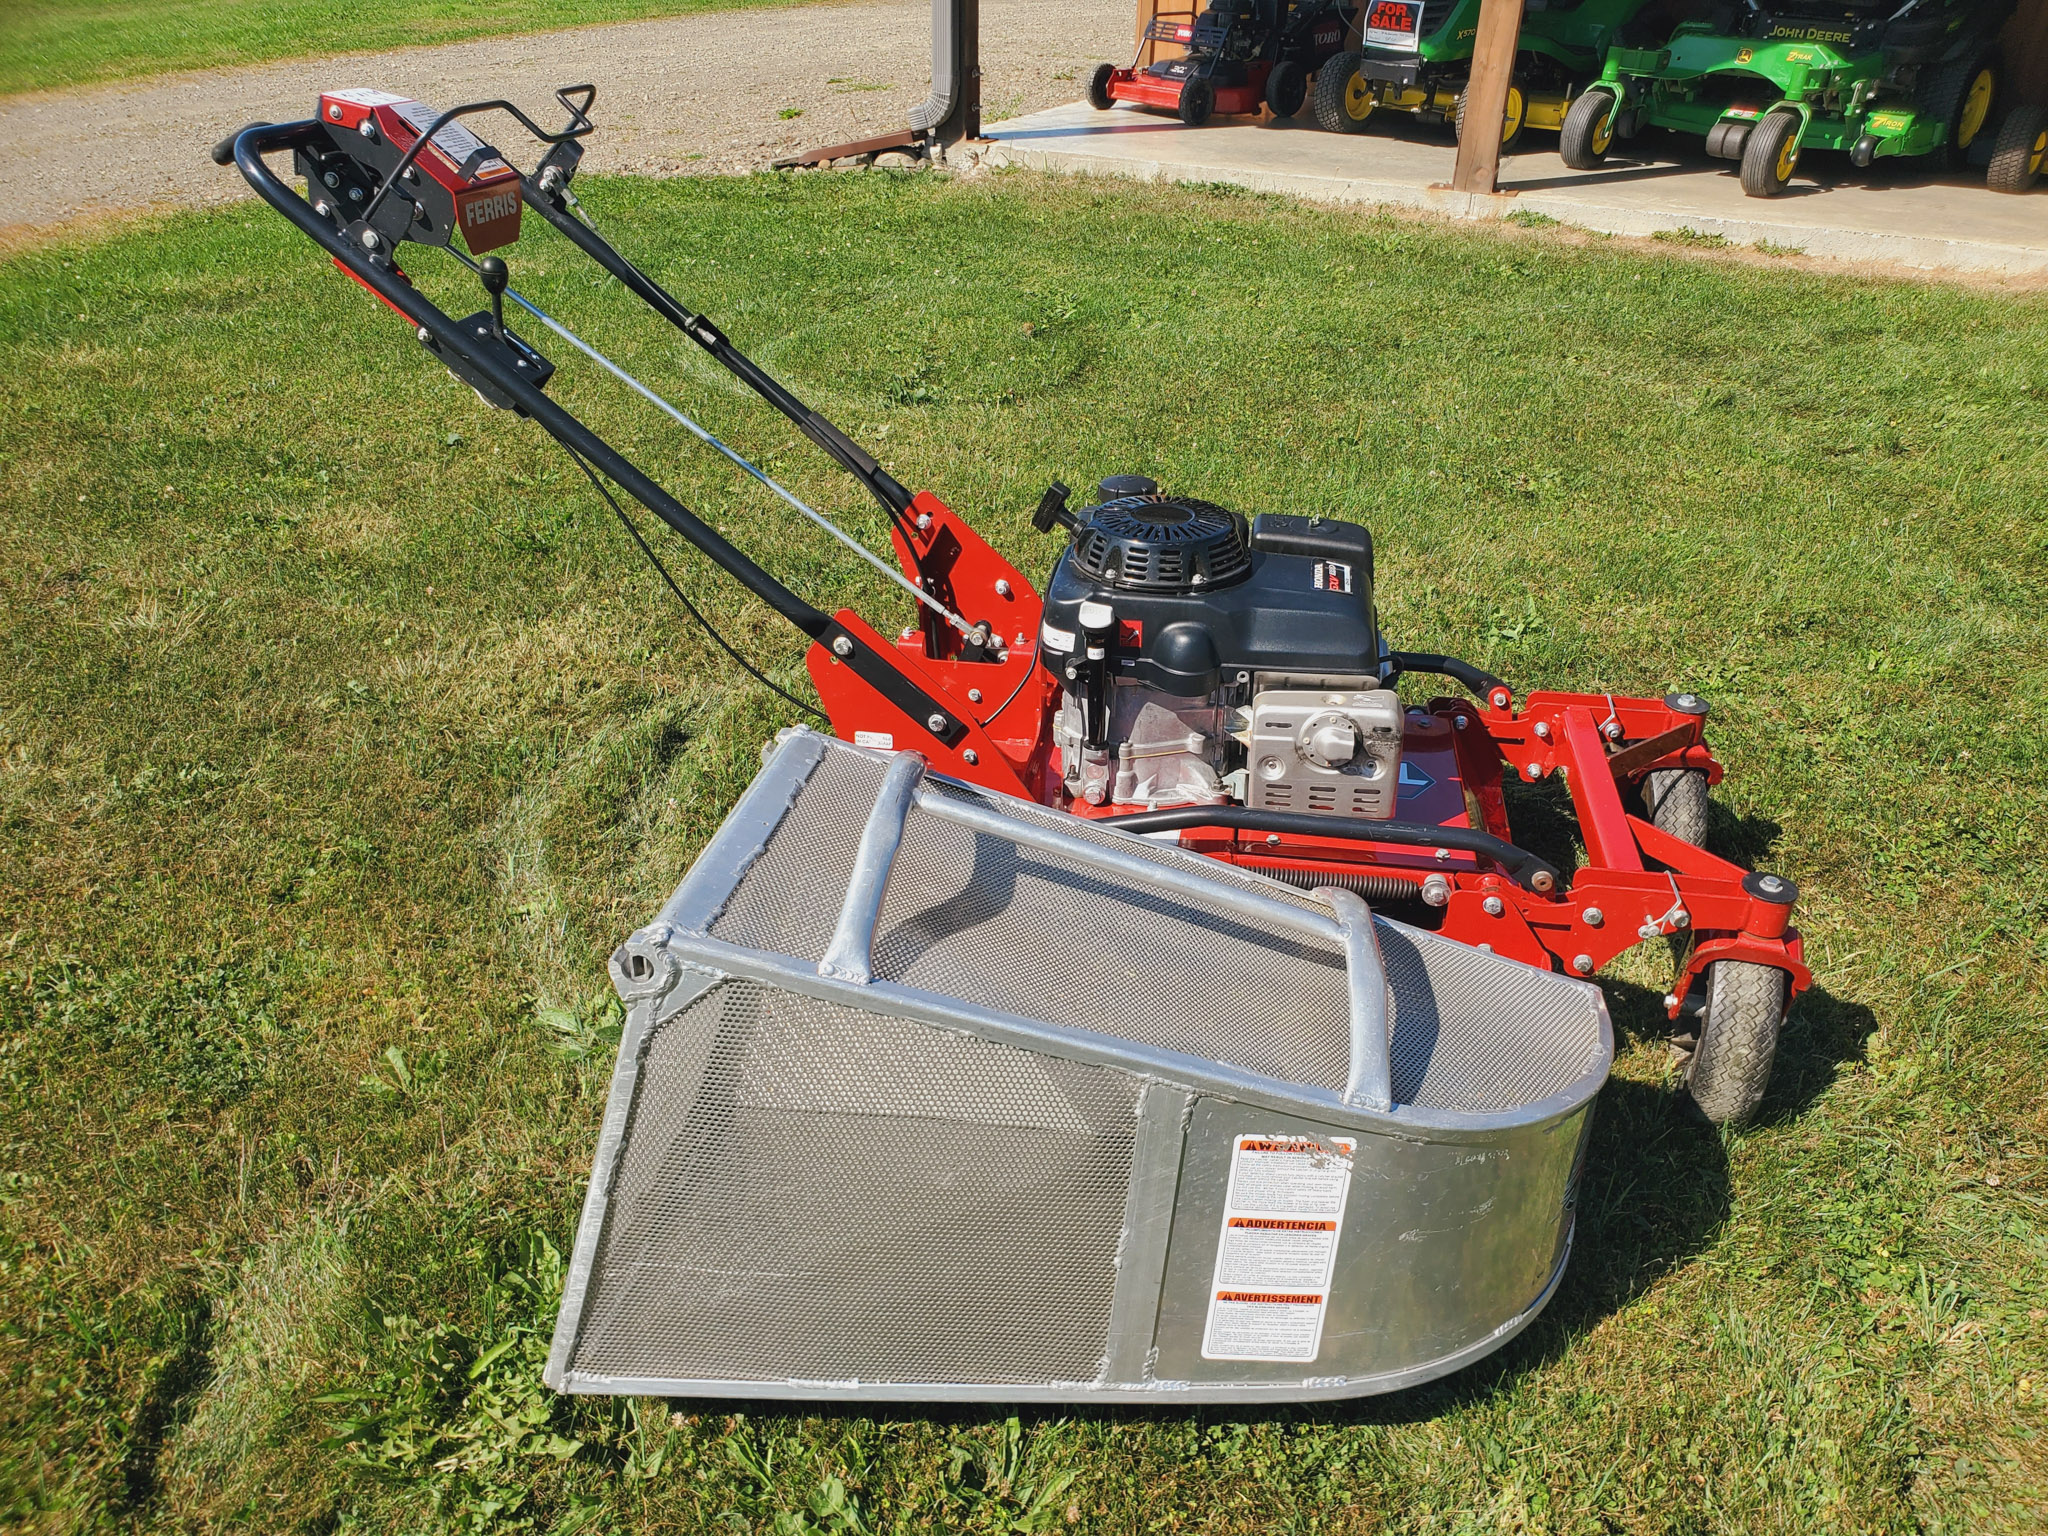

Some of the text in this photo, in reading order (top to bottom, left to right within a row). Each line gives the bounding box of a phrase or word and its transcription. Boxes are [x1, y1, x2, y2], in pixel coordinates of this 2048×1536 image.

[1377, 2, 1408, 17] FOR
[1370, 14, 1412, 31] SALE
[1313, 29, 1341, 46] TORO
[1457, 29, 1476, 40] X570
[1769, 25, 1851, 43] JOHN DEERE
[465, 191, 517, 227] FERRIS
[1313, 563, 1324, 589] HONDA
[1246, 1219, 1326, 1230] ADVERTENCIA
[1234, 1293, 1320, 1304] AVERTISSEMENT
